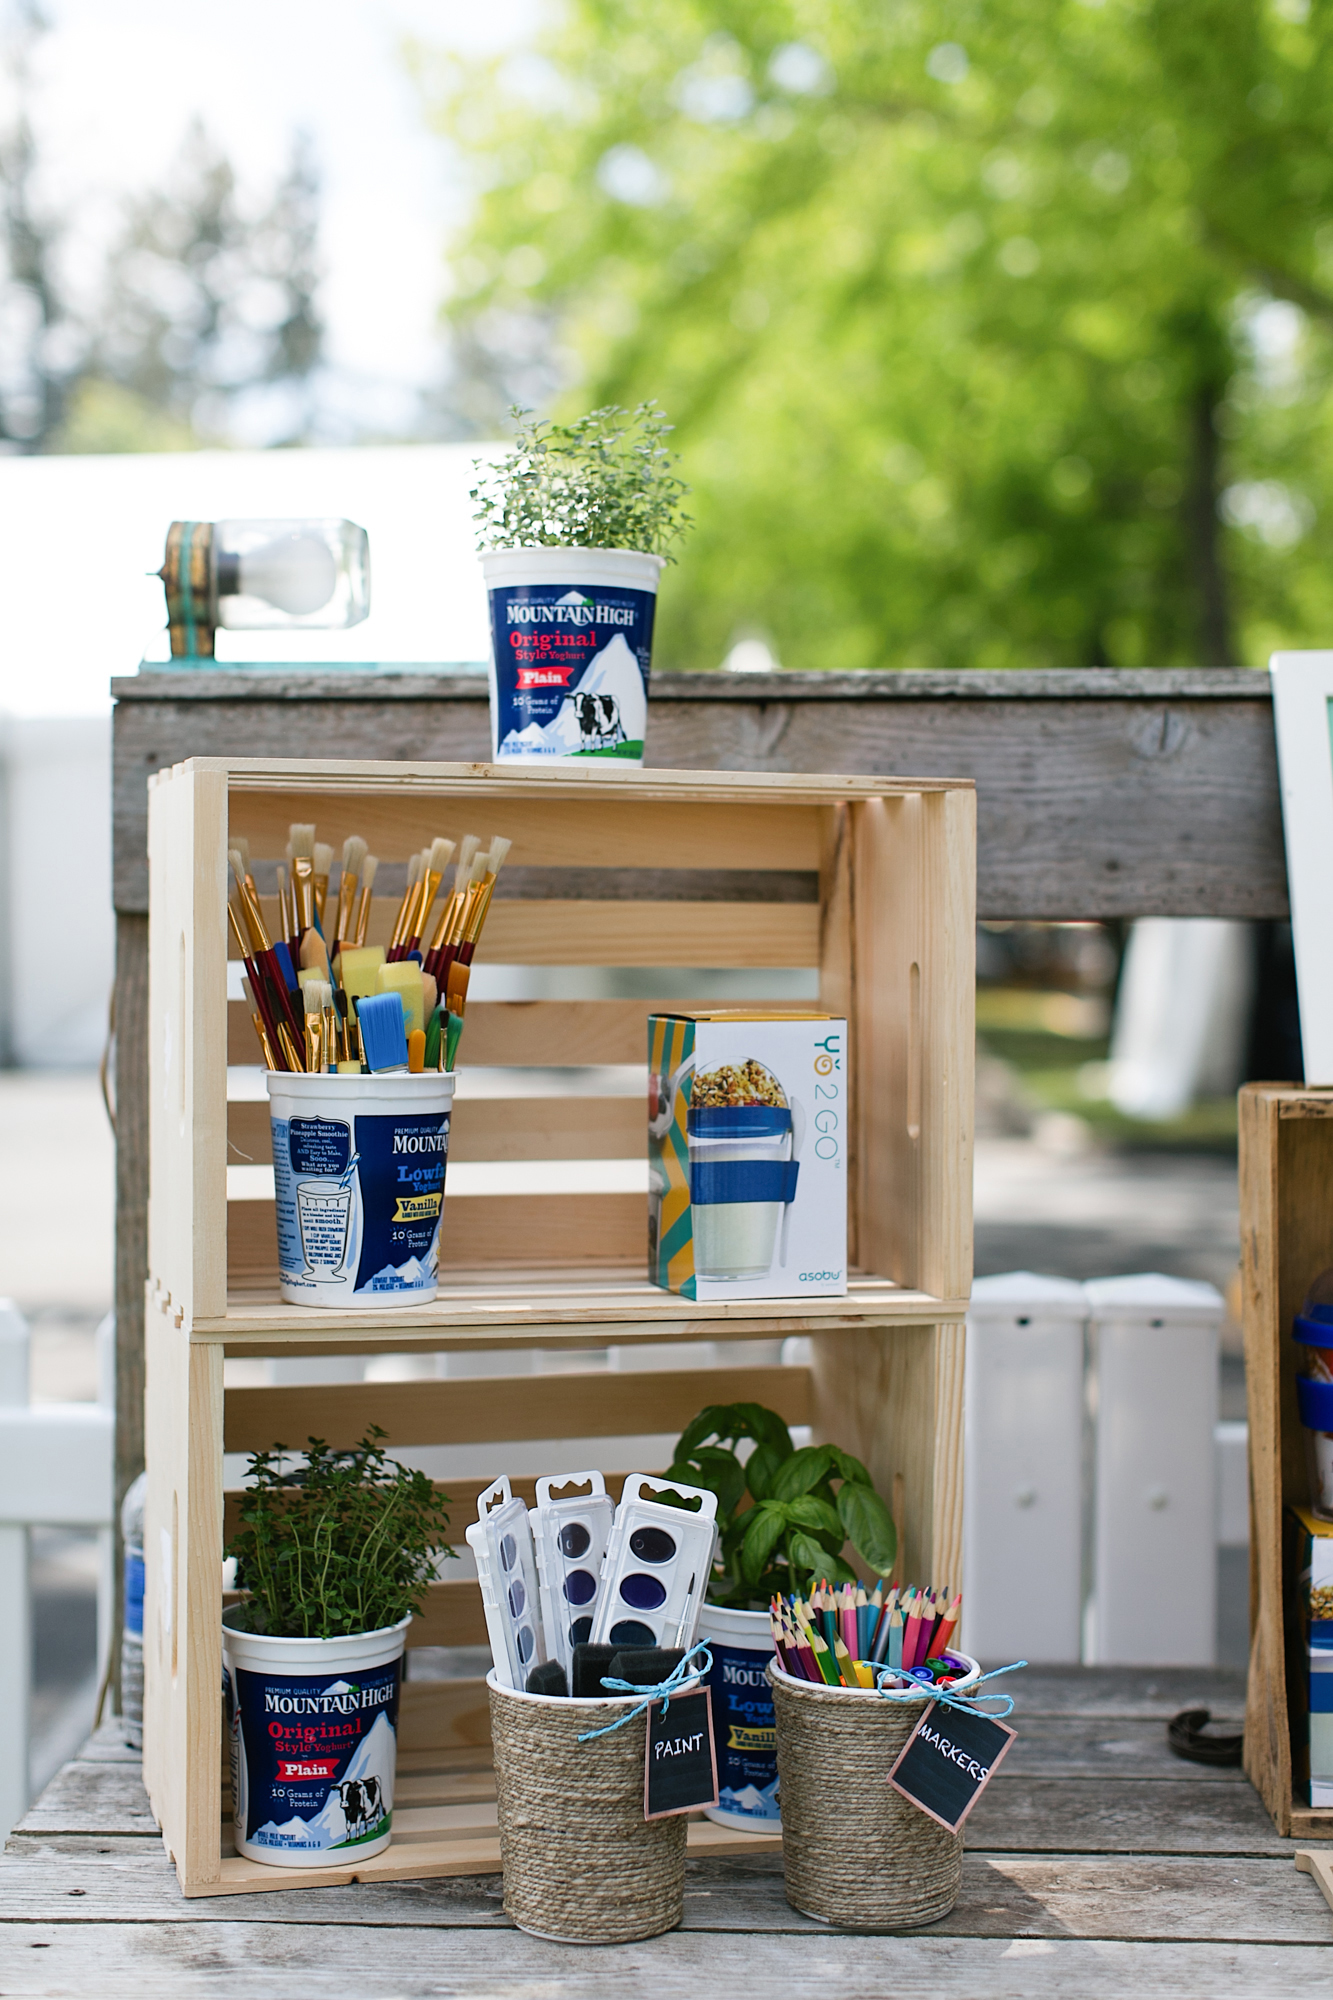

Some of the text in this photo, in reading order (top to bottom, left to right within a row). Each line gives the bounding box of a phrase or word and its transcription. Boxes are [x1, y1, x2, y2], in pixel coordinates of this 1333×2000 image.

[507, 605, 634, 627] MOUNTAIN HIGH
[509, 630, 597, 650] Original
[515, 650, 585, 662] Style Yoghurt
[523, 672, 562, 684] Plain
[513, 697, 524, 706] 10
[550, 695, 559, 705] of
[527, 705, 553, 714] Protein
[815, 1084, 838, 1100] 2
[290, 1129, 316, 1137] Pineapple
[301, 1123, 335, 1131] Strawberry
[420, 1126, 438, 1134] QUALITY
[400, 1198, 437, 1211] Vanilla
[392, 1227, 433, 1240] 10 Grams of
[408, 1239, 428, 1248] Protein
[798, 1270, 840, 1281] asobu
[265, 1686, 291, 1694] PREMIUM
[293, 1687, 321, 1695] QUALITY
[265, 1683, 394, 1714] MOUNTAIN HIGH
[268, 1718, 362, 1743] Original
[275, 1740, 352, 1755] Style Yoghurt
[654, 1733, 704, 1760] PAINT
[917, 1723, 990, 1782] MARKERS
[285, 1763, 328, 1776] Plain
[271, 1788, 325, 1798] 10 Grams of
[289, 1798, 319, 1807] Protein
